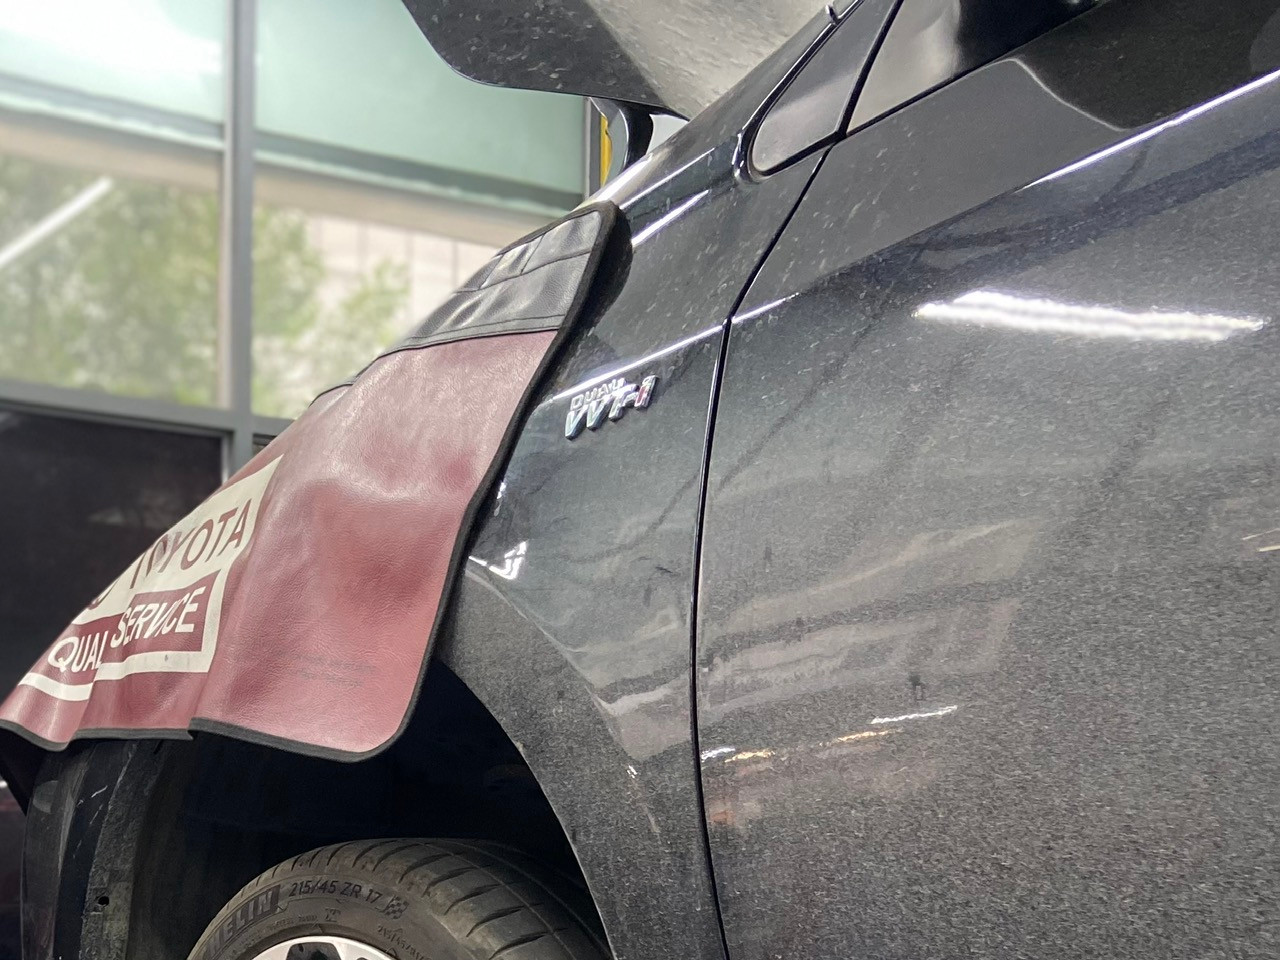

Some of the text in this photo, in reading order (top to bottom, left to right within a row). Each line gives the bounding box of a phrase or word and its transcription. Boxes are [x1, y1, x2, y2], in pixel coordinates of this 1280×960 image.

[110, 586, 207, 649] SERVICE
[288, 879, 339, 898] 215/45
[339, 881, 362, 899] ZR
[365, 888, 382, 904] 17
